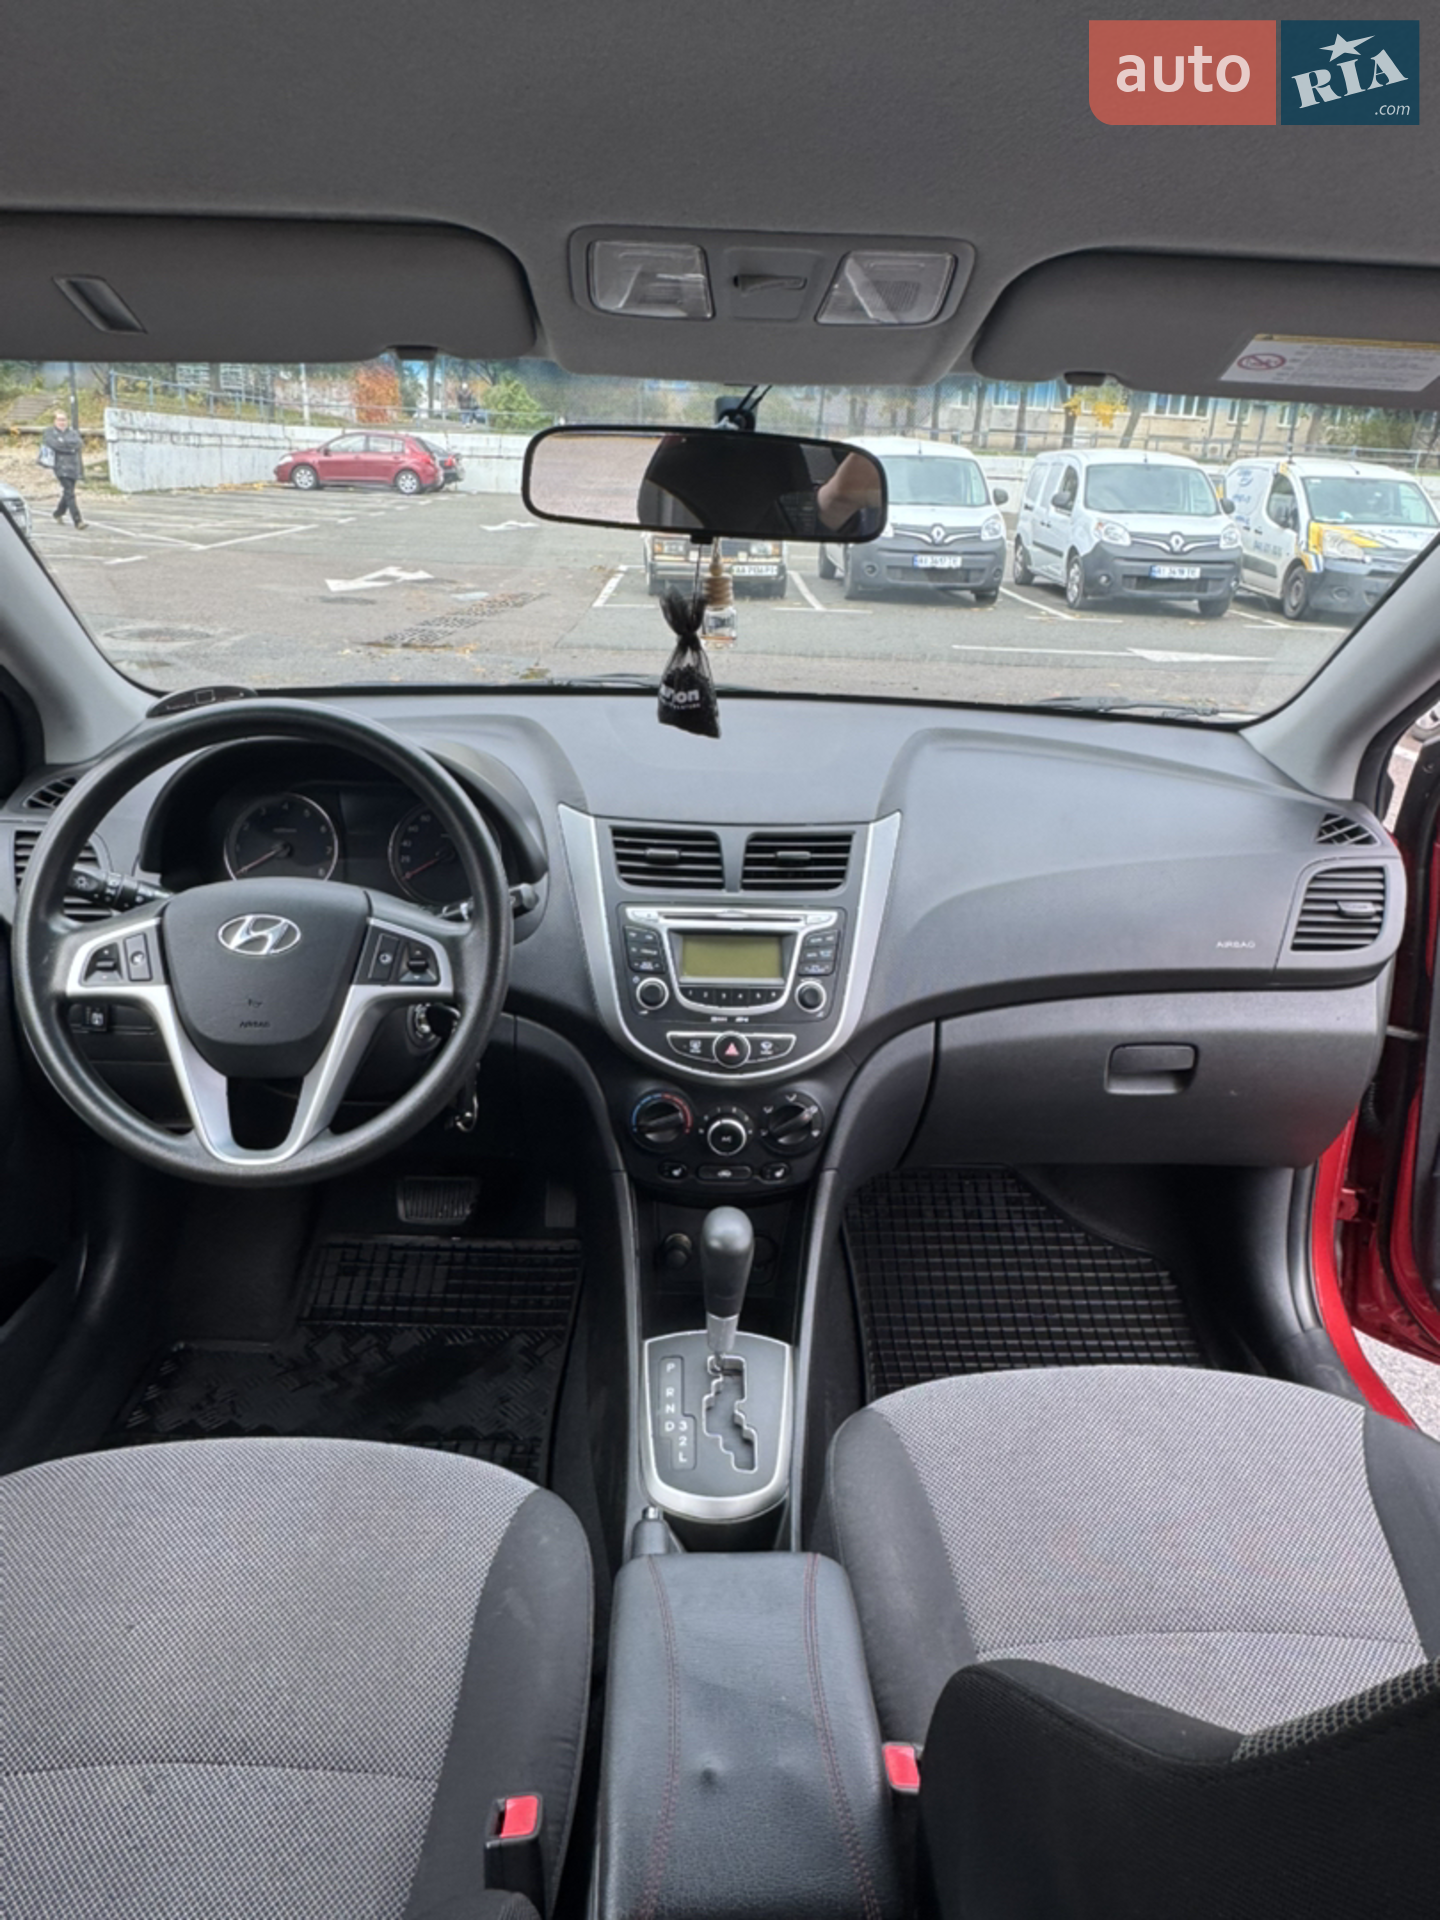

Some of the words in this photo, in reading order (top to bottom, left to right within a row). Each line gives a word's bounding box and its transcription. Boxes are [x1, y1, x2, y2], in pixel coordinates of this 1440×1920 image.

[666, 1362, 676, 1373] P
[666, 1388, 675, 1397] R
[666, 1404, 675, 1413] N
[665, 1421, 675, 1432] D
[679, 1421, 688, 1431] 3
[679, 1436, 688, 1447] 2
[679, 1452, 687, 1463] L
